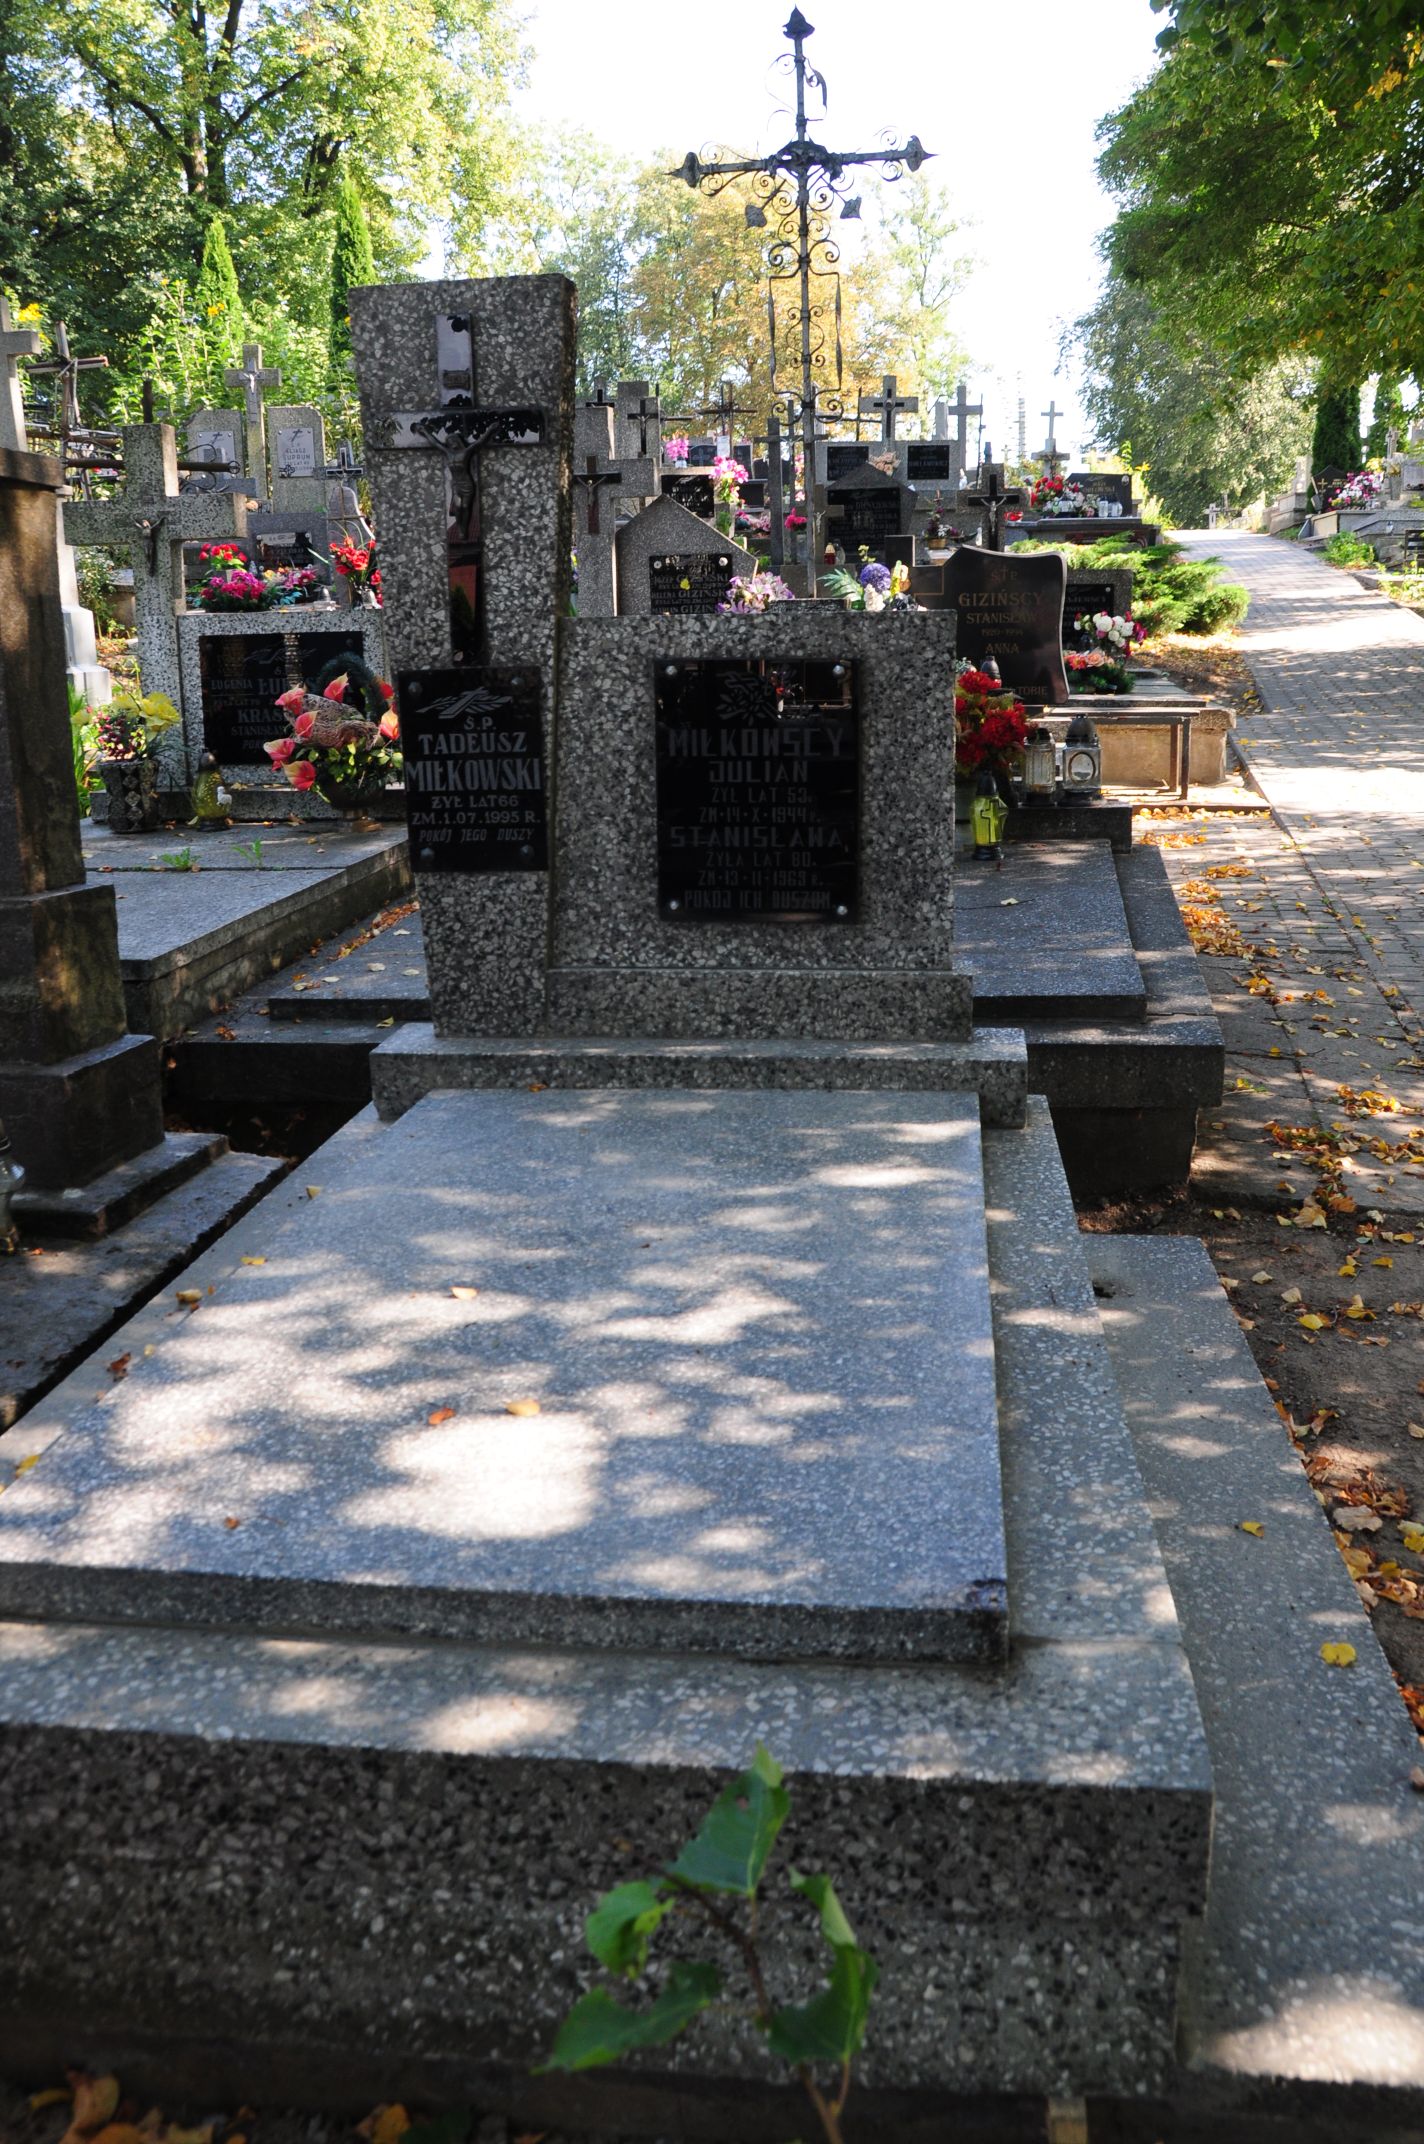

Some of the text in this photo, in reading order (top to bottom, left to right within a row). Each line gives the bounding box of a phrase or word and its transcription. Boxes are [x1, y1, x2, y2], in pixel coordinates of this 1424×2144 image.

[984, 642, 1020, 655] ANNA
[418, 731, 528, 755] TADEUSZ
[669, 728, 844, 758] MIŁKOWSCY
[404, 758, 542, 792] MIŁKOWSKI
[708, 760, 809, 783] JULIAN
[747, 786, 778, 803] LAT
[460, 829, 488, 844] JEGO
[496, 828, 535, 842] DUSZY
[752, 850, 785, 867] LAT
[739, 889, 763, 909] ICH
